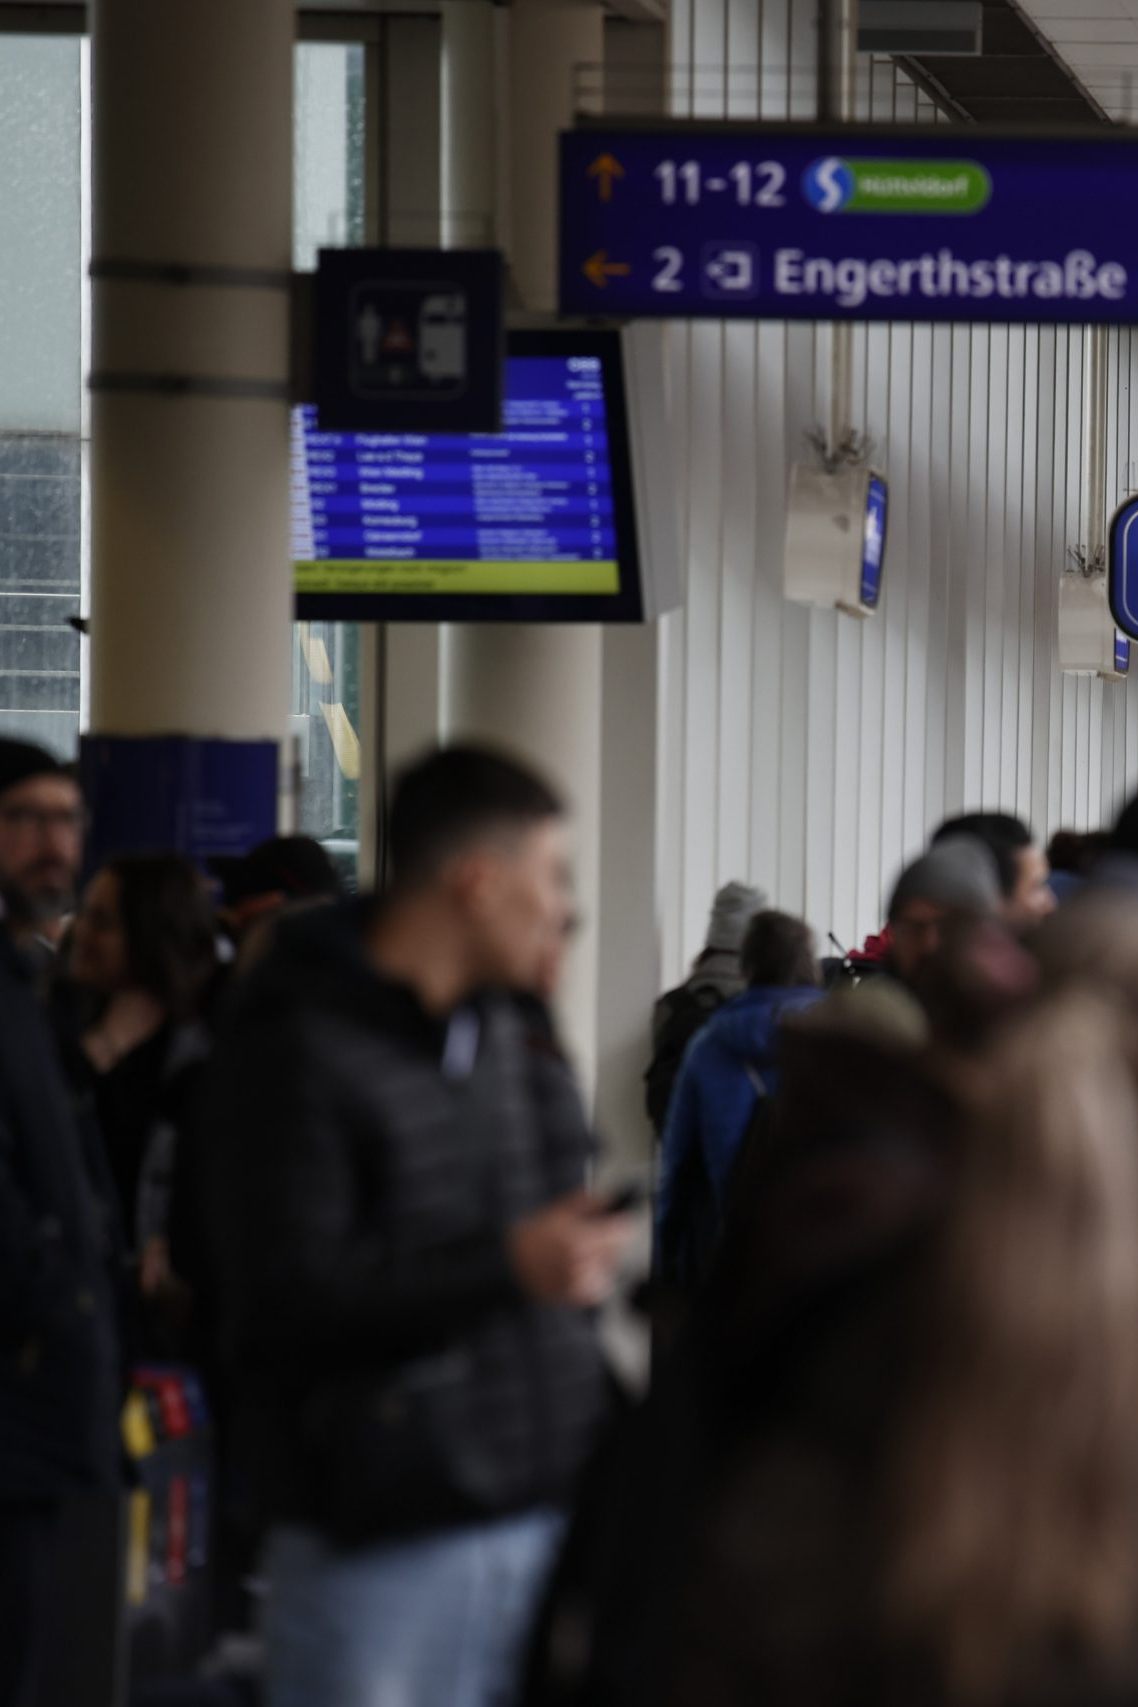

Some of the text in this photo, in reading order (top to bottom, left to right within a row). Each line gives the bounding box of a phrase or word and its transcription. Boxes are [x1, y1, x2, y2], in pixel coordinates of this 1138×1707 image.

[655, 161, 786, 208] 11-12
[651, 246, 684, 293] 2
[773, 248, 1128, 307] Engerthstraße
